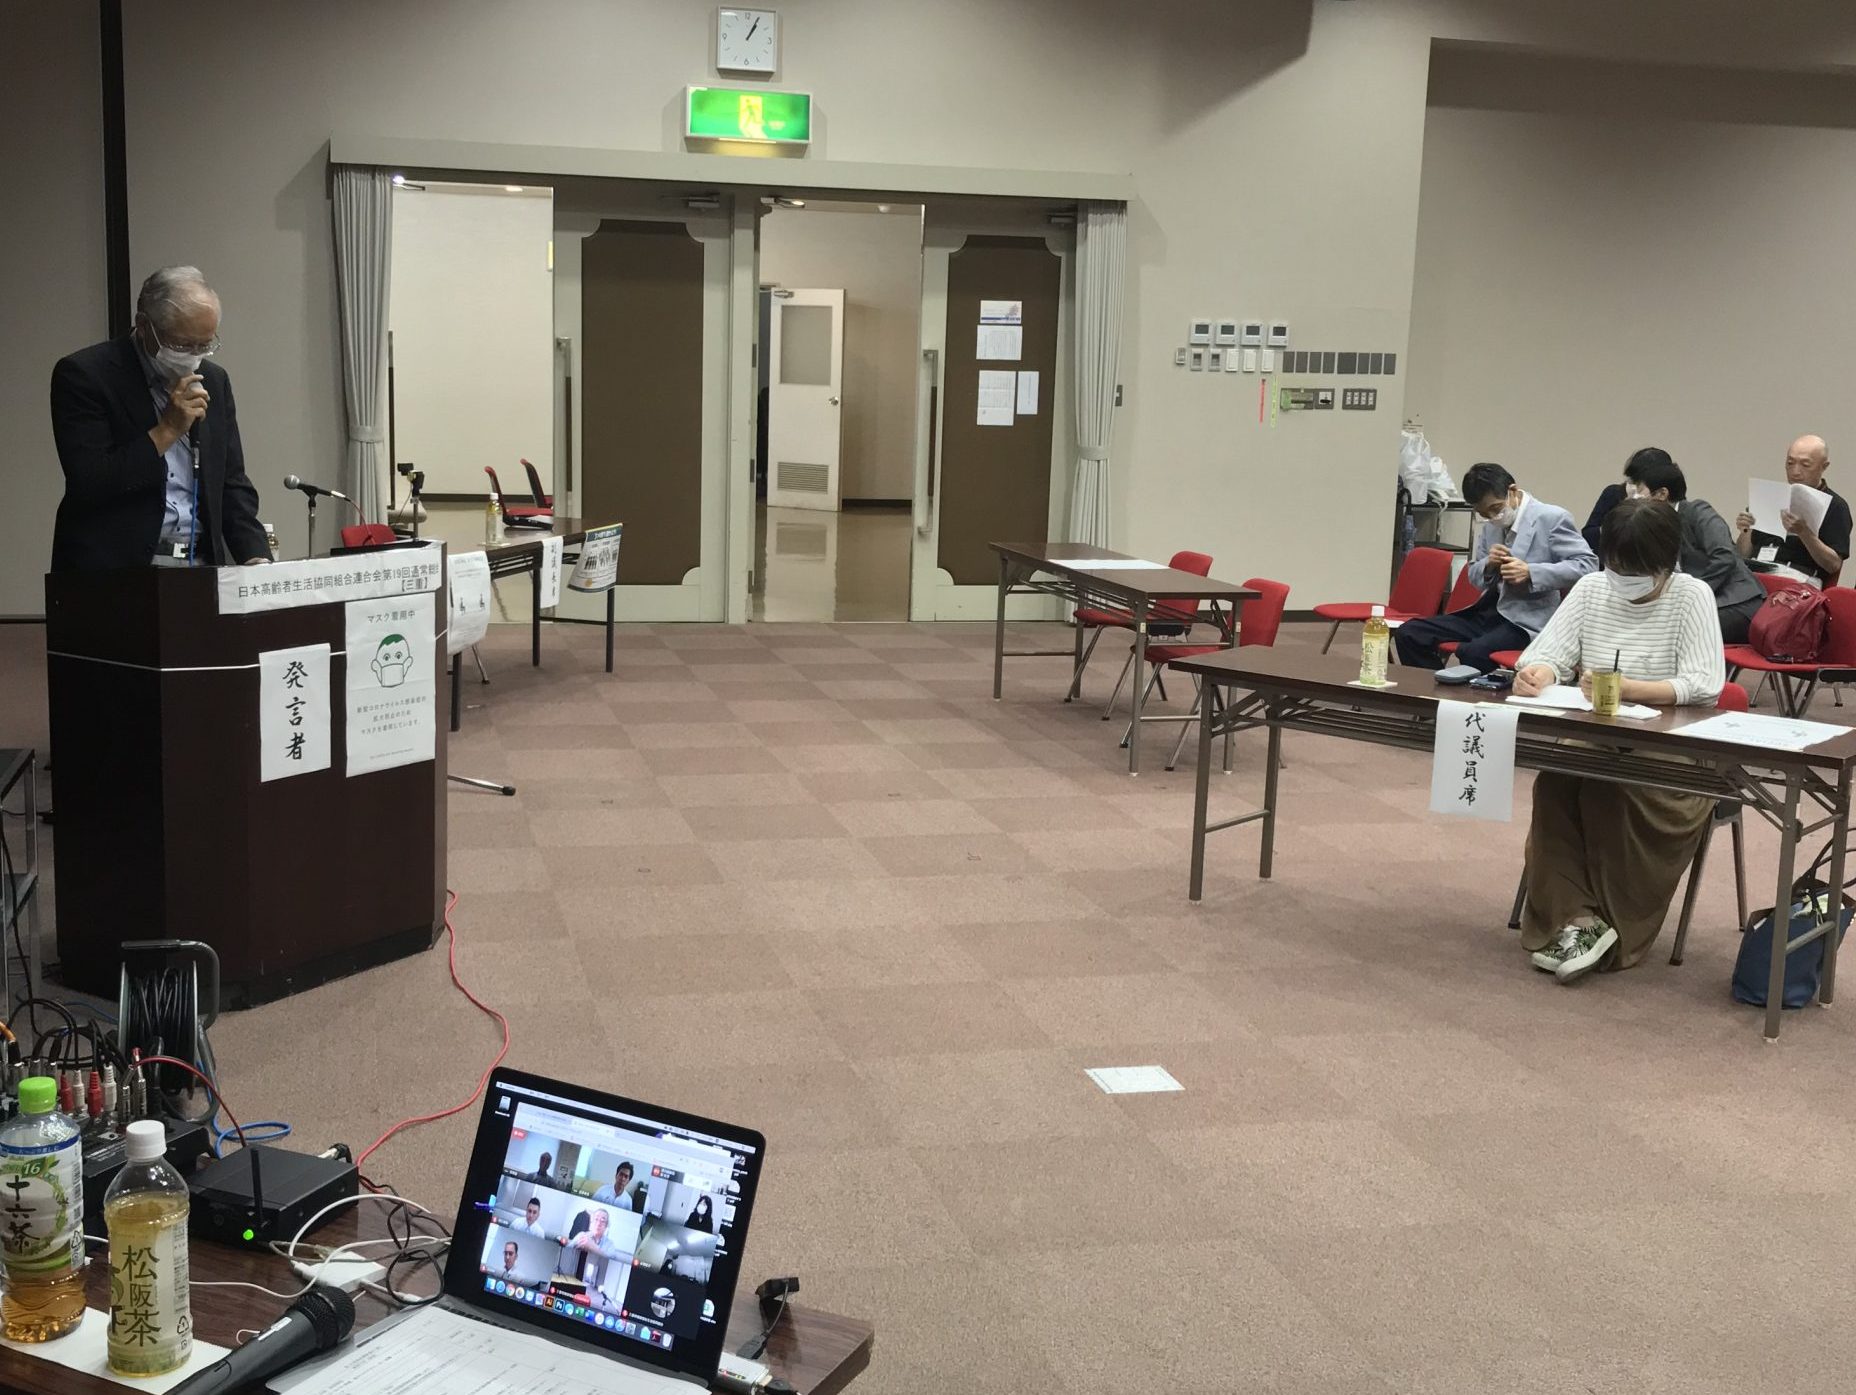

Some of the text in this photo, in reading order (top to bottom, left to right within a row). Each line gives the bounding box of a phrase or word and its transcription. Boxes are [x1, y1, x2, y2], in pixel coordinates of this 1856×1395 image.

[744, 12, 752, 20] 12
[282, 661, 308, 760] 発言者
[1458, 712, 1486, 806] 代議員席
[23, 1162, 41, 1176] 16
[4, 1174, 40, 1255] 十六茶
[121, 1244, 162, 1347] 松阪茶
